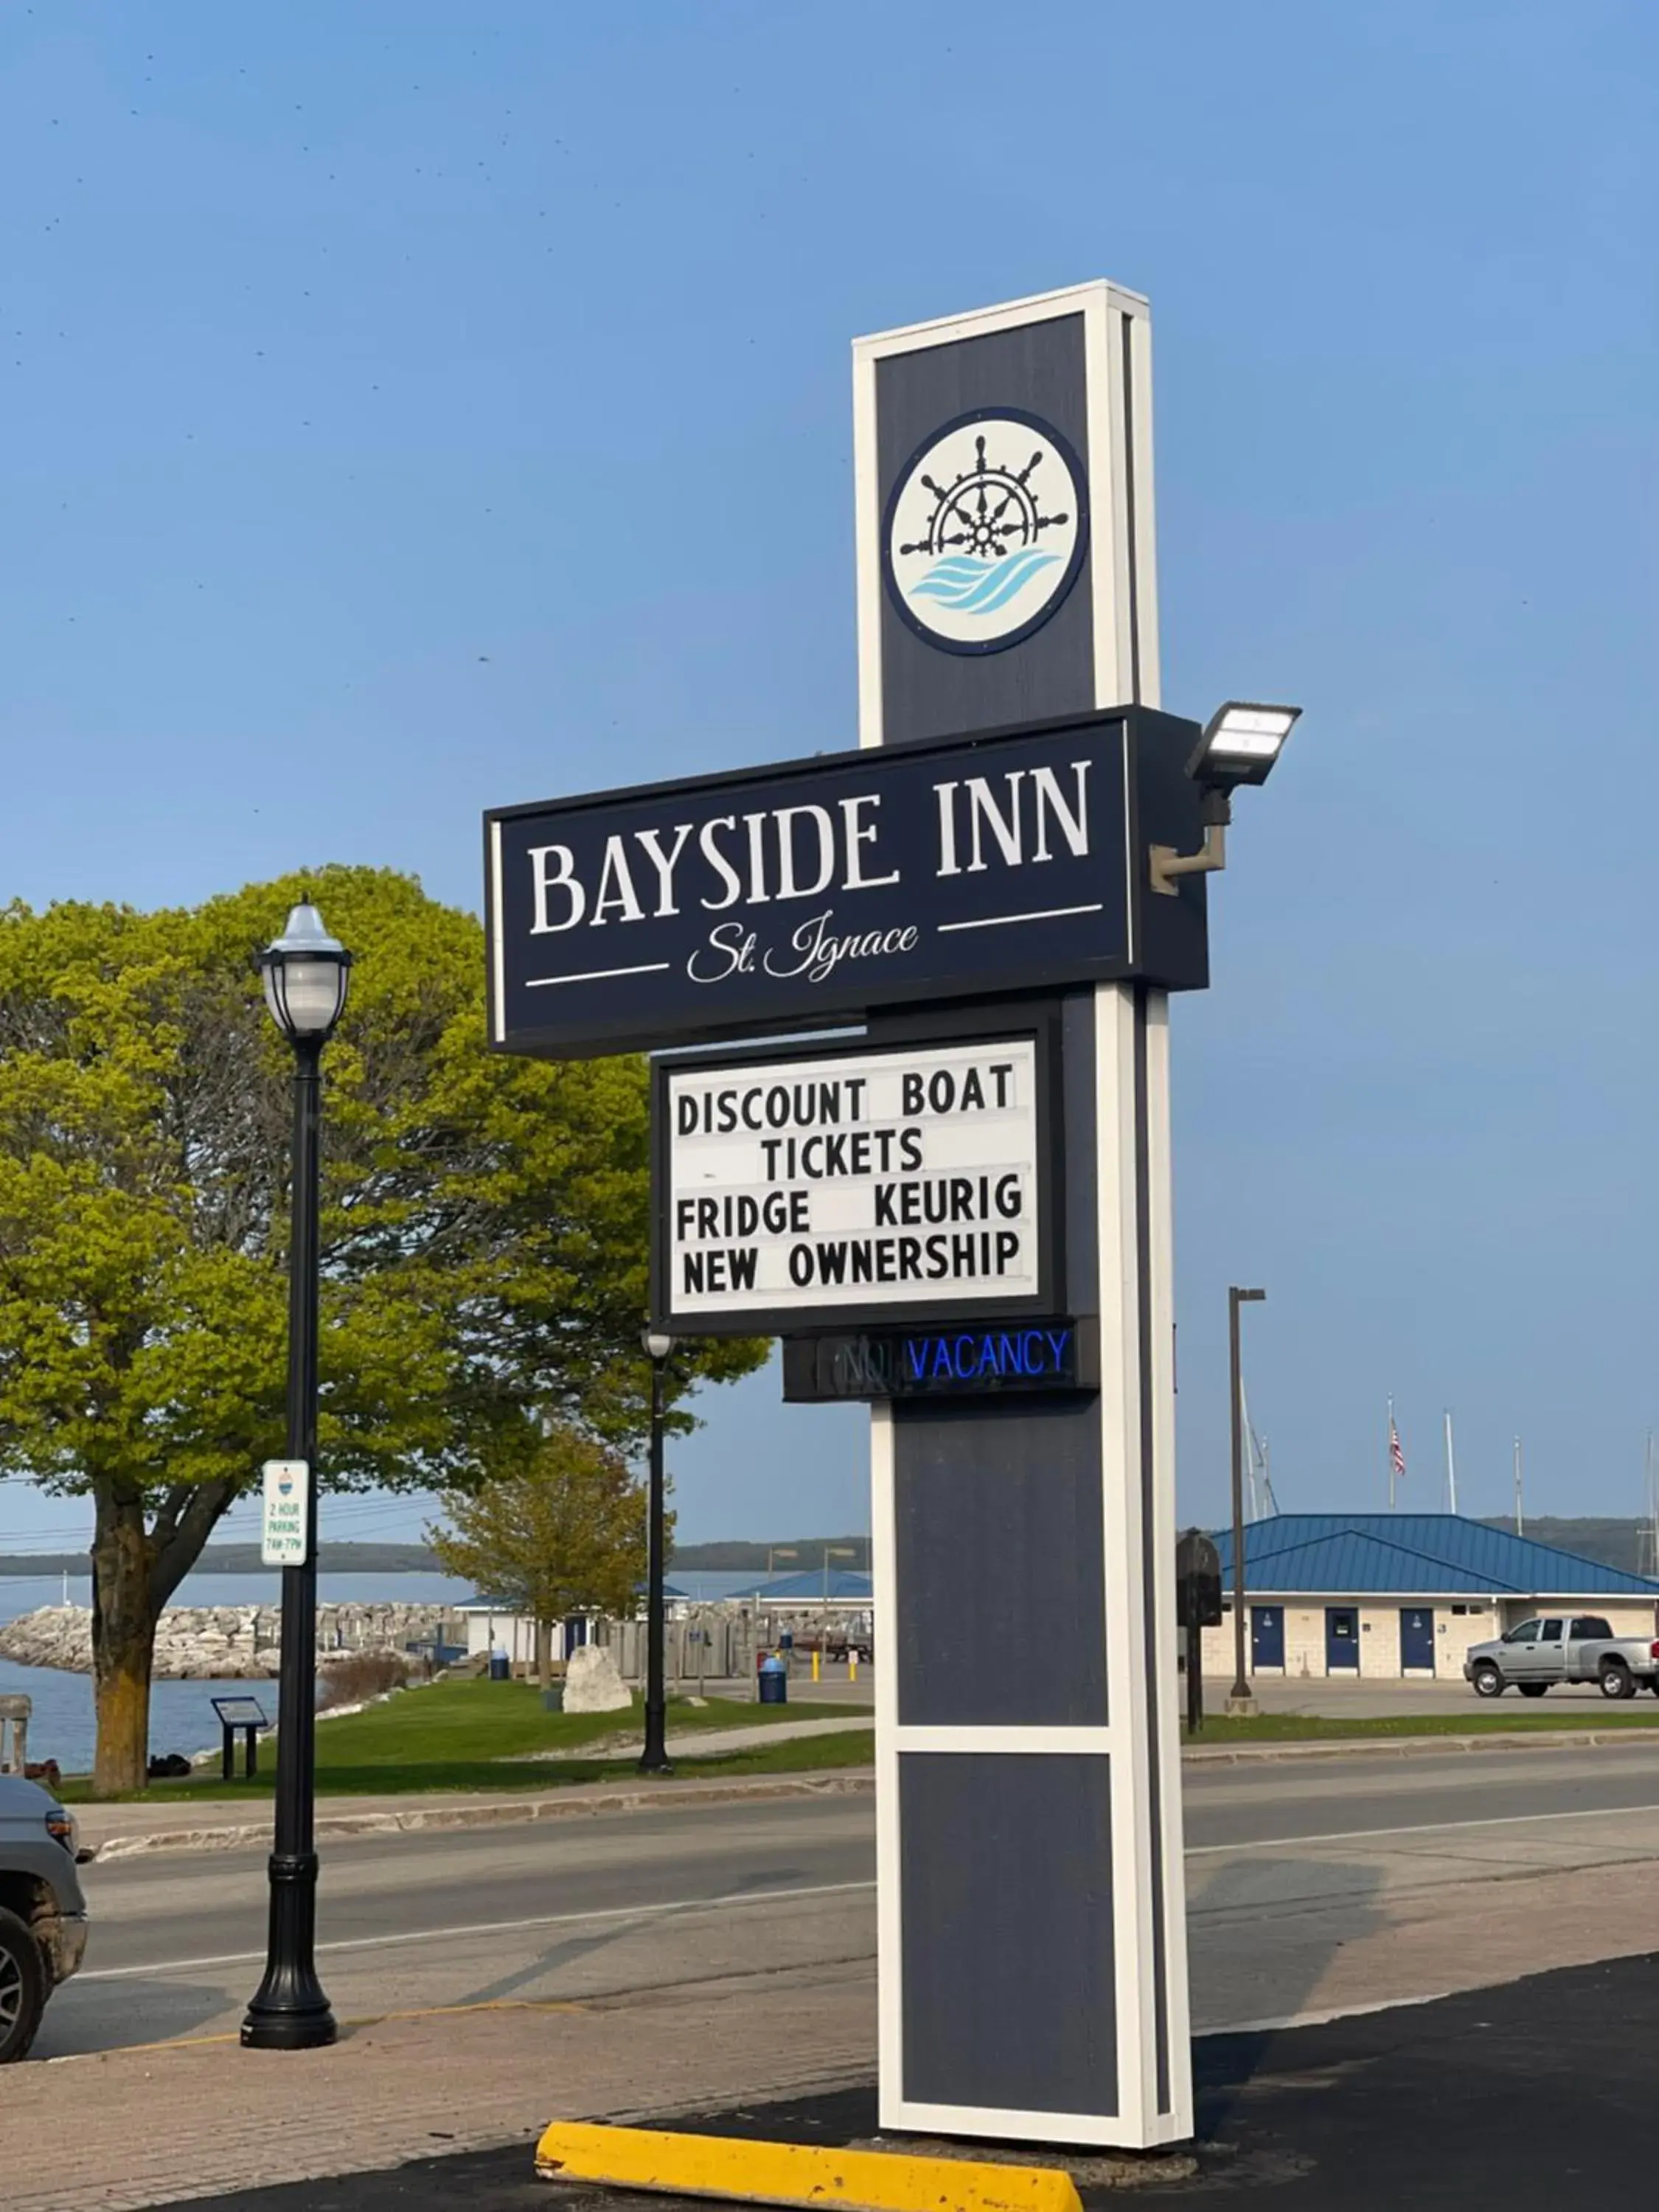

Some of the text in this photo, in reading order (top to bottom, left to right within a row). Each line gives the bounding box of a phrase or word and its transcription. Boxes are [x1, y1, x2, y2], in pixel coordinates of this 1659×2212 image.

[526, 759, 1093, 935] BAYSIDE INN
[687, 909, 919, 983] St. Ignace
[678, 1064, 1012, 1136] DISCOUNT BOAT
[761, 1127, 922, 1181] TICKETS
[677, 1174, 1022, 1241] FRIDGE KEURIG
[684, 1231, 1019, 1294] NEW OWNERSHIP
[907, 1330, 1069, 1380] VACANCY
[268, 1520, 300, 1534] PARKING
[270, 1503, 299, 1516] 2 HOUR
